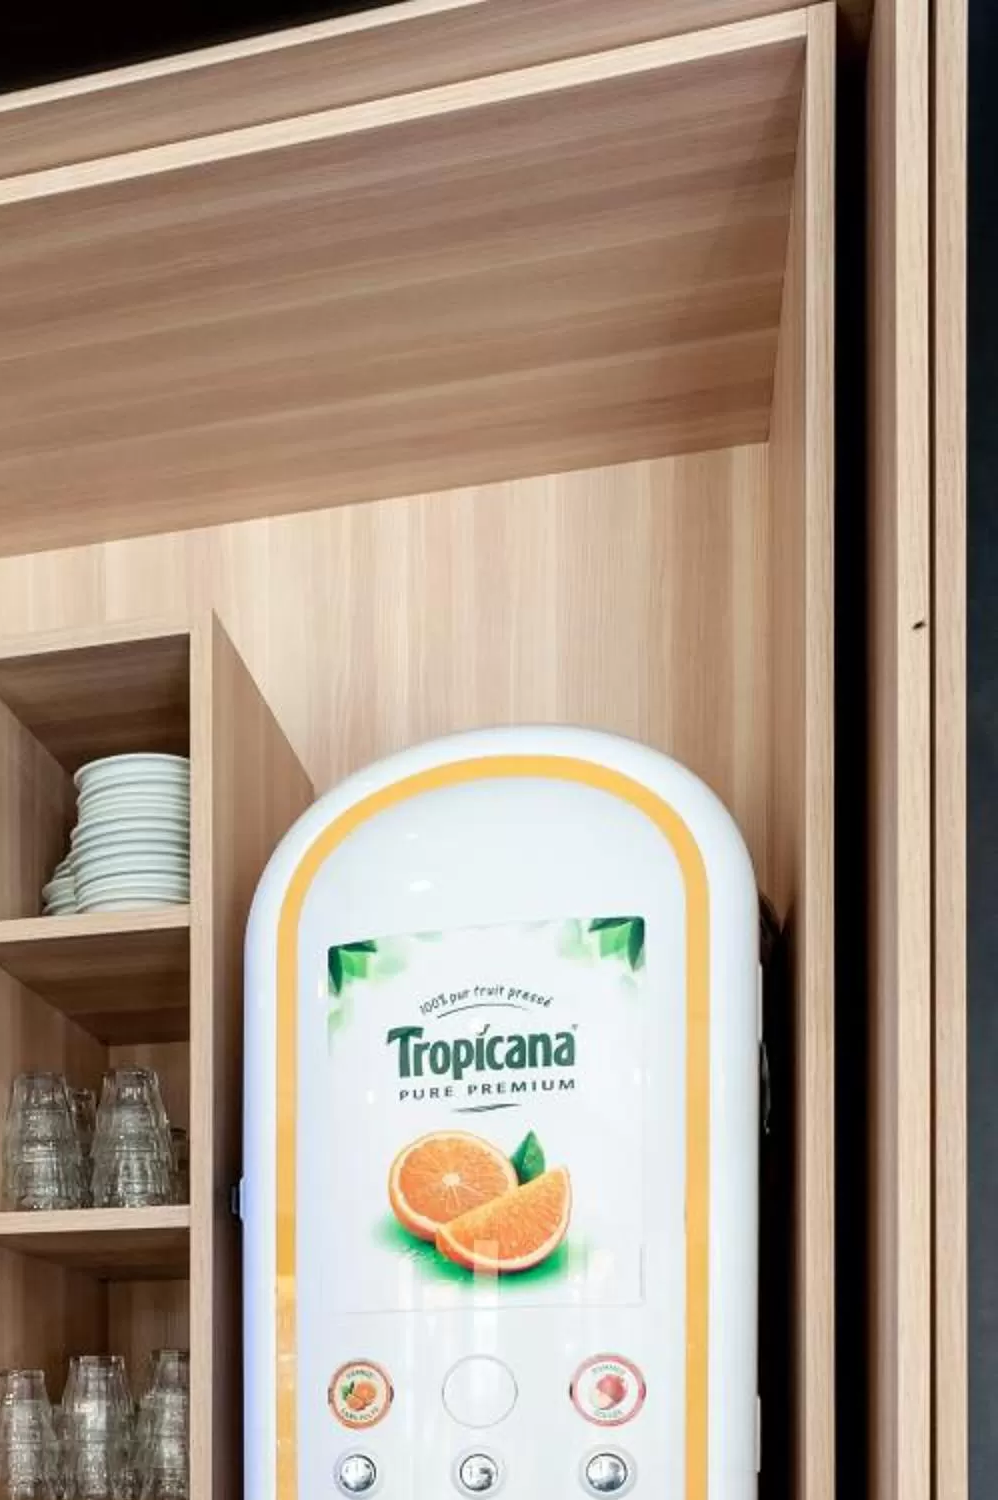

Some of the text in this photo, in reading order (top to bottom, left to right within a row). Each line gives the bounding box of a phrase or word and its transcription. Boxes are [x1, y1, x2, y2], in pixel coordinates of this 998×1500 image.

[419, 993, 449, 1015] 100%
[450, 989, 470, 1005] pur
[474, 985, 505, 997] fruit
[386, 1024, 576, 1080] Tropicana
[399, 1079, 576, 1101] PURE PREMIUM
